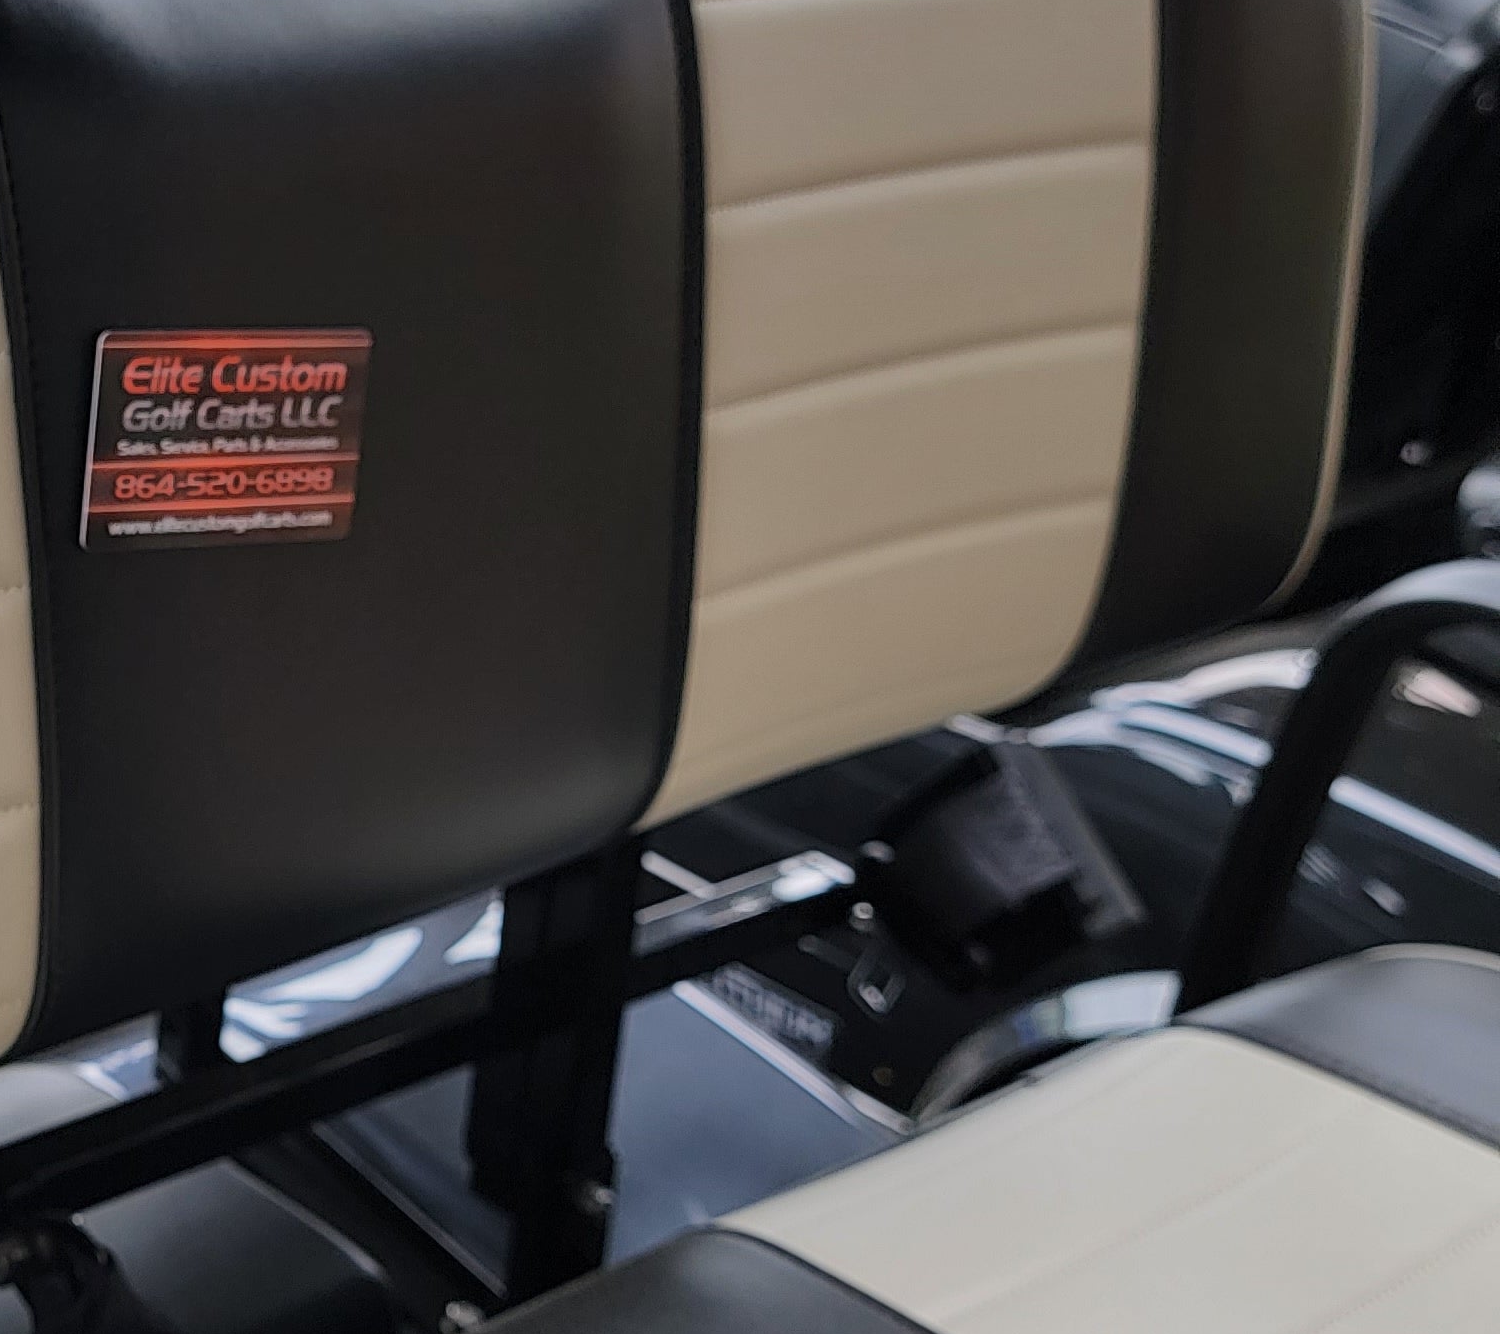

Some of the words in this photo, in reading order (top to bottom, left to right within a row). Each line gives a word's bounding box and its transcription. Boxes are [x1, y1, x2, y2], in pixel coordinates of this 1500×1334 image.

[122, 355, 204, 394] Elite
[211, 354, 347, 393] Custom
[122, 397, 193, 432] Golf
[196, 396, 275, 430] Carts
[280, 394, 343, 428] LLC
